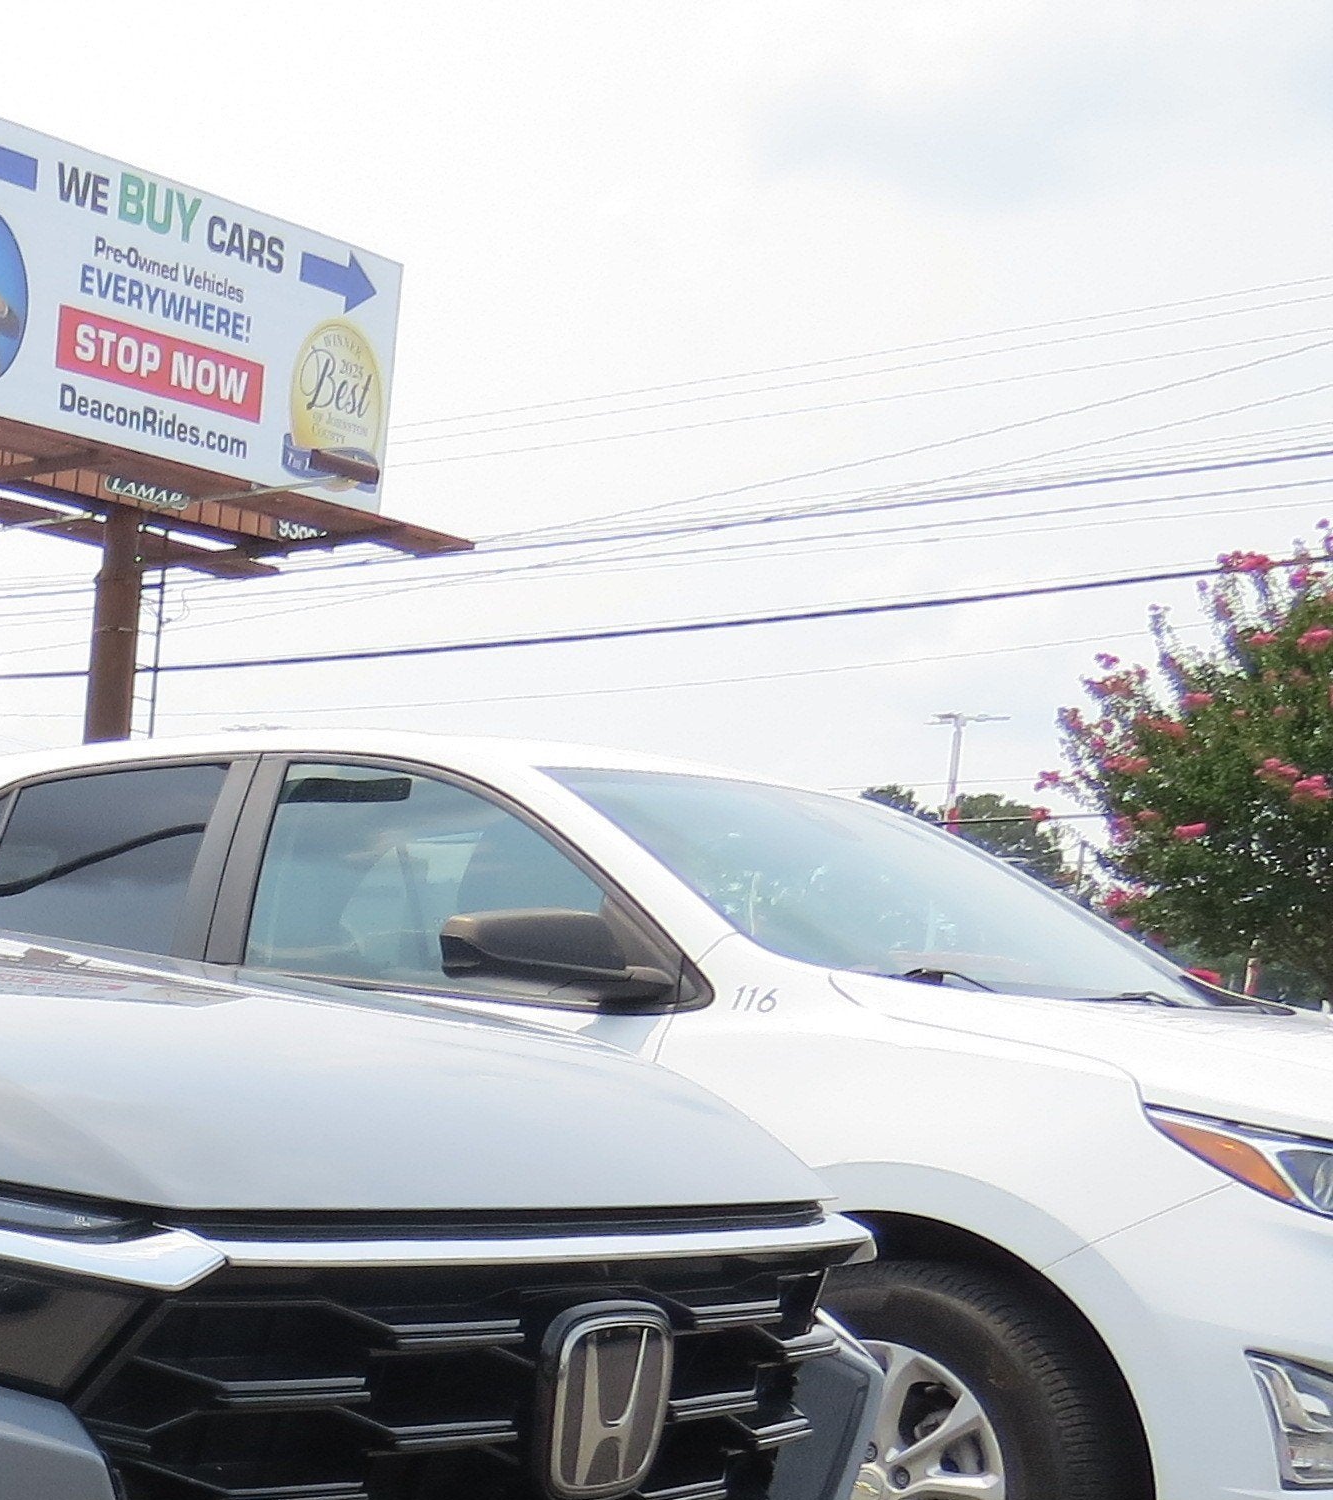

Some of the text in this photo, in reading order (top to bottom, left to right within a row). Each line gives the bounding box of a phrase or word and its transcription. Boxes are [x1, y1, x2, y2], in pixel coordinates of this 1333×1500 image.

[58, 161, 285, 274] WE BUY CARS
[80, 263, 252, 343] EVERYWHERE!
[94, 236, 244, 303] Pre-Owned Vehicles
[75, 323, 248, 405] STOP NOW
[300, 345, 373, 418] Best
[59, 383, 247, 459] DeaconRides.com
[731, 984, 779, 1013] 116
